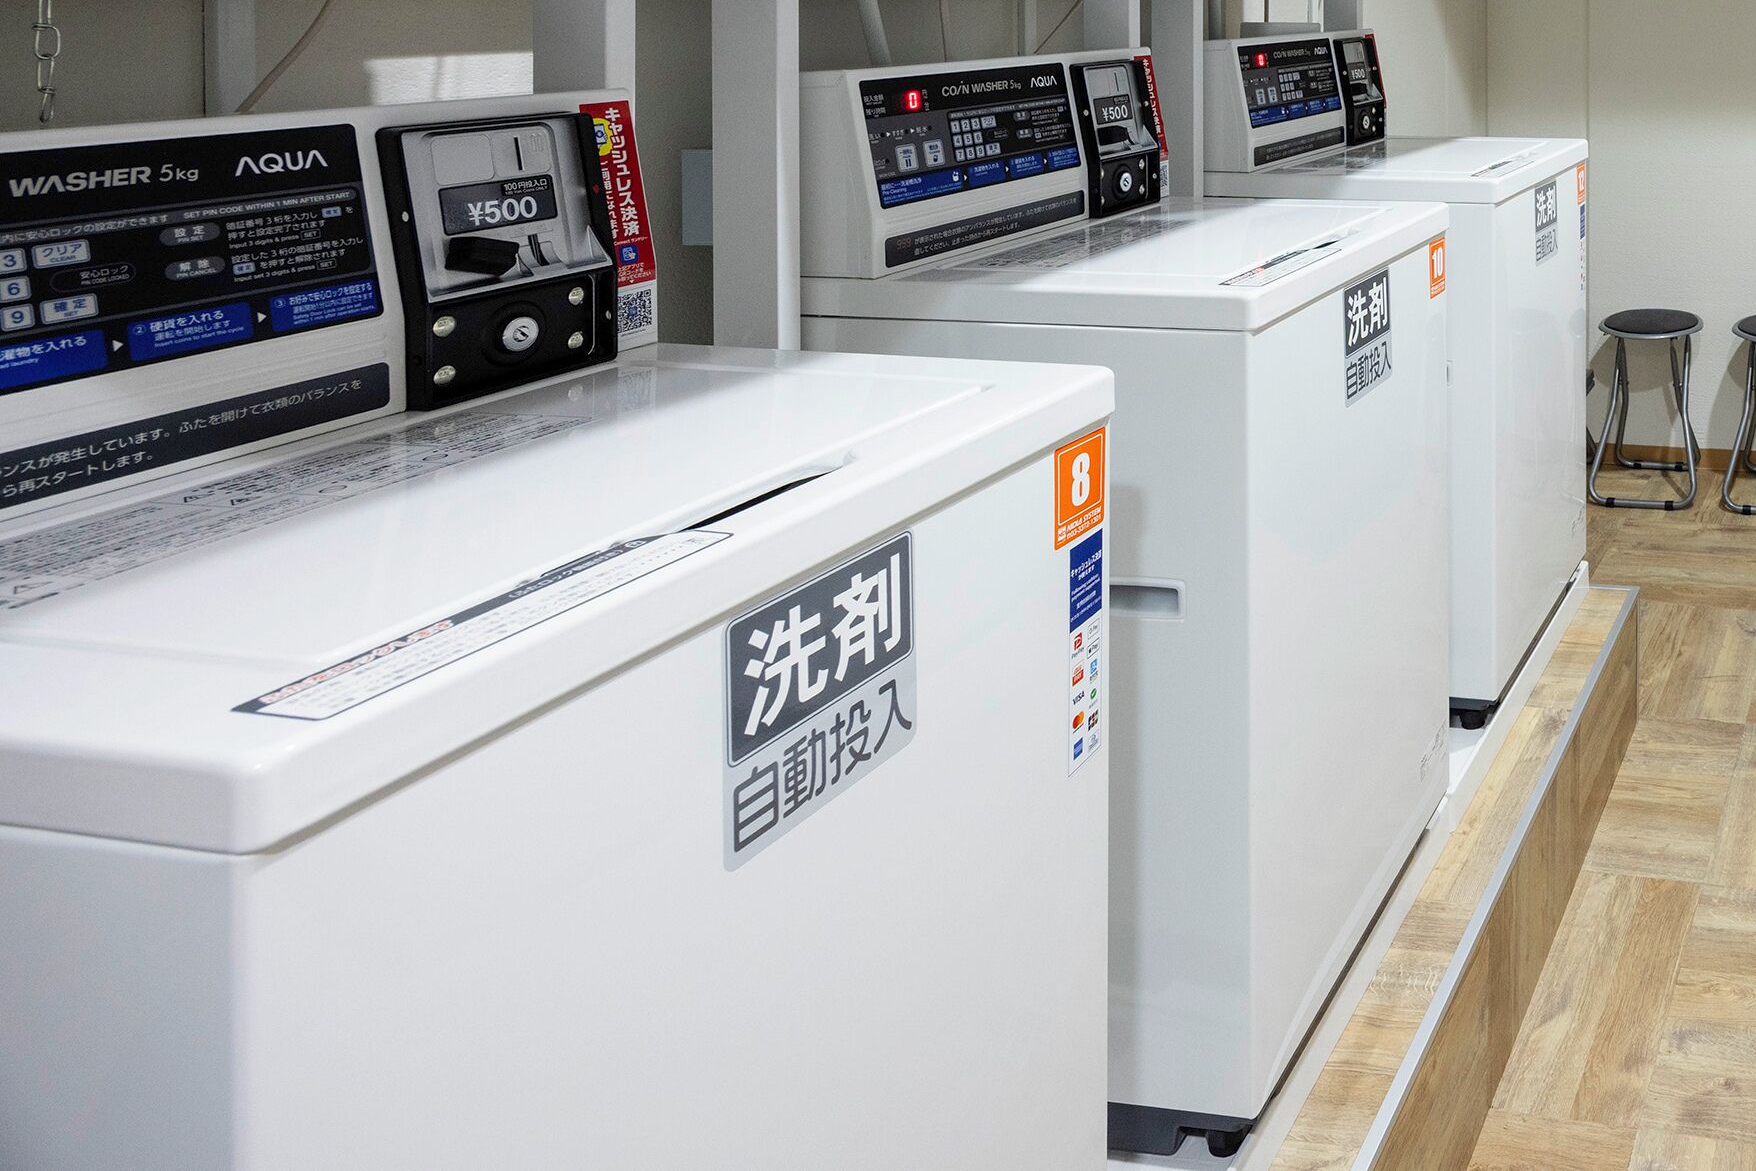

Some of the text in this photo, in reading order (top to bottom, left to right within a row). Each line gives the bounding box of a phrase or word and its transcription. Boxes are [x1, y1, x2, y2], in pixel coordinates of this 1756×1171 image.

[971, 79, 1009, 94] WASHER
[1010, 79, 1022, 91] 5kg
[1030, 75, 1058, 89] AQUA
[908, 92, 918, 109] 0
[1102, 104, 1129, 122] ¥500
[9, 149, 328, 198] WASHER 5kg AQUA
[504, 179, 548, 191] 100円投入口
[605, 108, 640, 237] キャッシュレス決済
[184, 210, 200, 220] SET
[202, 208, 217, 217] PIN
[219, 205, 244, 215] CODE
[245, 202, 274, 212] WITHIN
[282, 198, 298, 208] MIN
[300, 195, 325, 204] AFTER
[325, 191, 350, 201] START
[467, 196, 538, 226] ¥500
[1536, 185, 1557, 227] 洗剤
[173, 225, 206, 239] 設定
[1536, 229, 1558, 262] 自動投入
[3, 243, 82, 268] 3 クリア
[179, 259, 211, 273] 解除
[1431, 246, 1443, 279] 10
[79, 265, 130, 281] 安心ロック
[7, 282, 21, 296] 6
[11, 297, 88, 325] 9 確定
[150, 309, 225, 332] 硬貨を入れる
[1347, 277, 1388, 347] 洗剤
[0, 335, 88, 361] 濯物を入れる
[1346, 341, 1391, 399] 自動投入
[1071, 451, 1091, 507] 8
[743, 553, 901, 736] 洗剤
[734, 678, 912, 853] 自動投入
